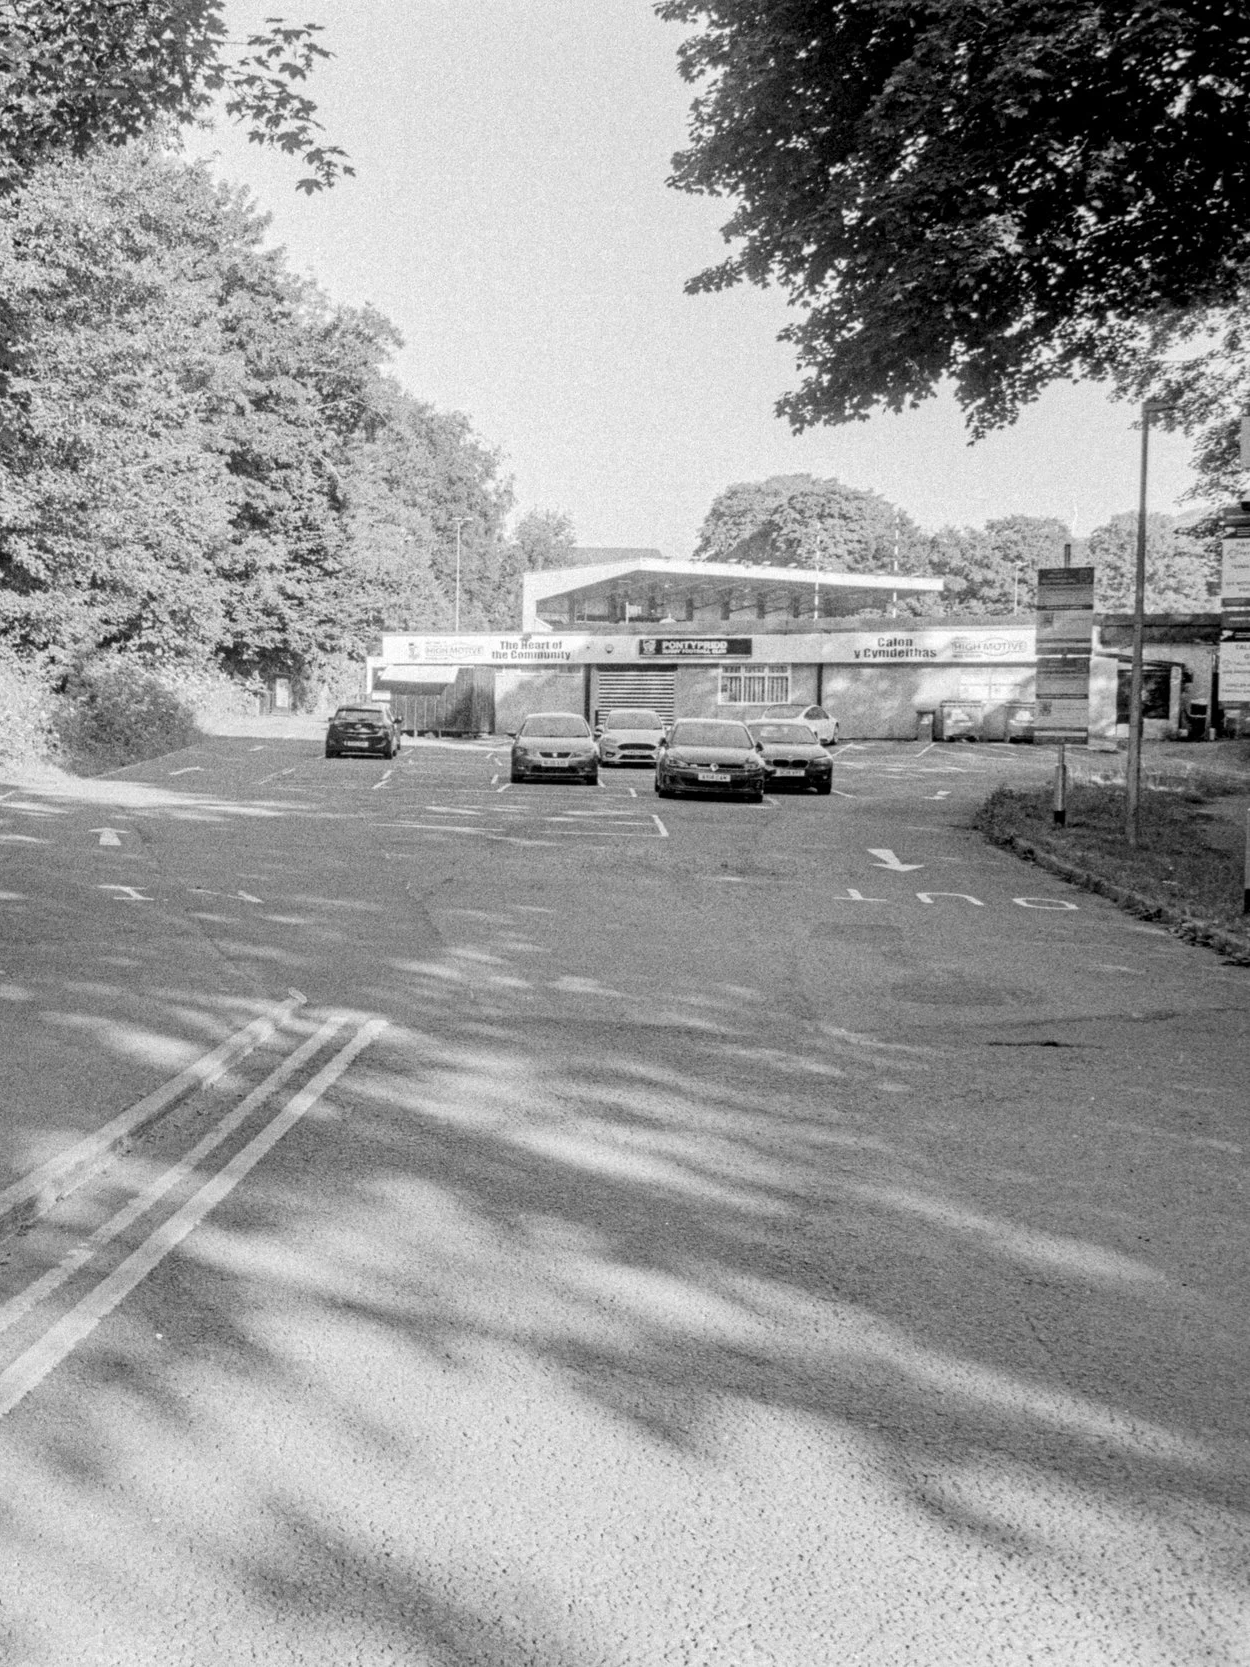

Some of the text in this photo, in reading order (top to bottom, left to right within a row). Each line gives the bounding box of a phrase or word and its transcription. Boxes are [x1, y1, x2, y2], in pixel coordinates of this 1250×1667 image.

[500, 641, 563, 650] The Heart of
[662, 641, 728, 650] PONTYPRIDD
[877, 637, 914, 648] Calon
[492, 650, 571, 661] the Community
[863, 647, 937, 659] Cymdeithas
